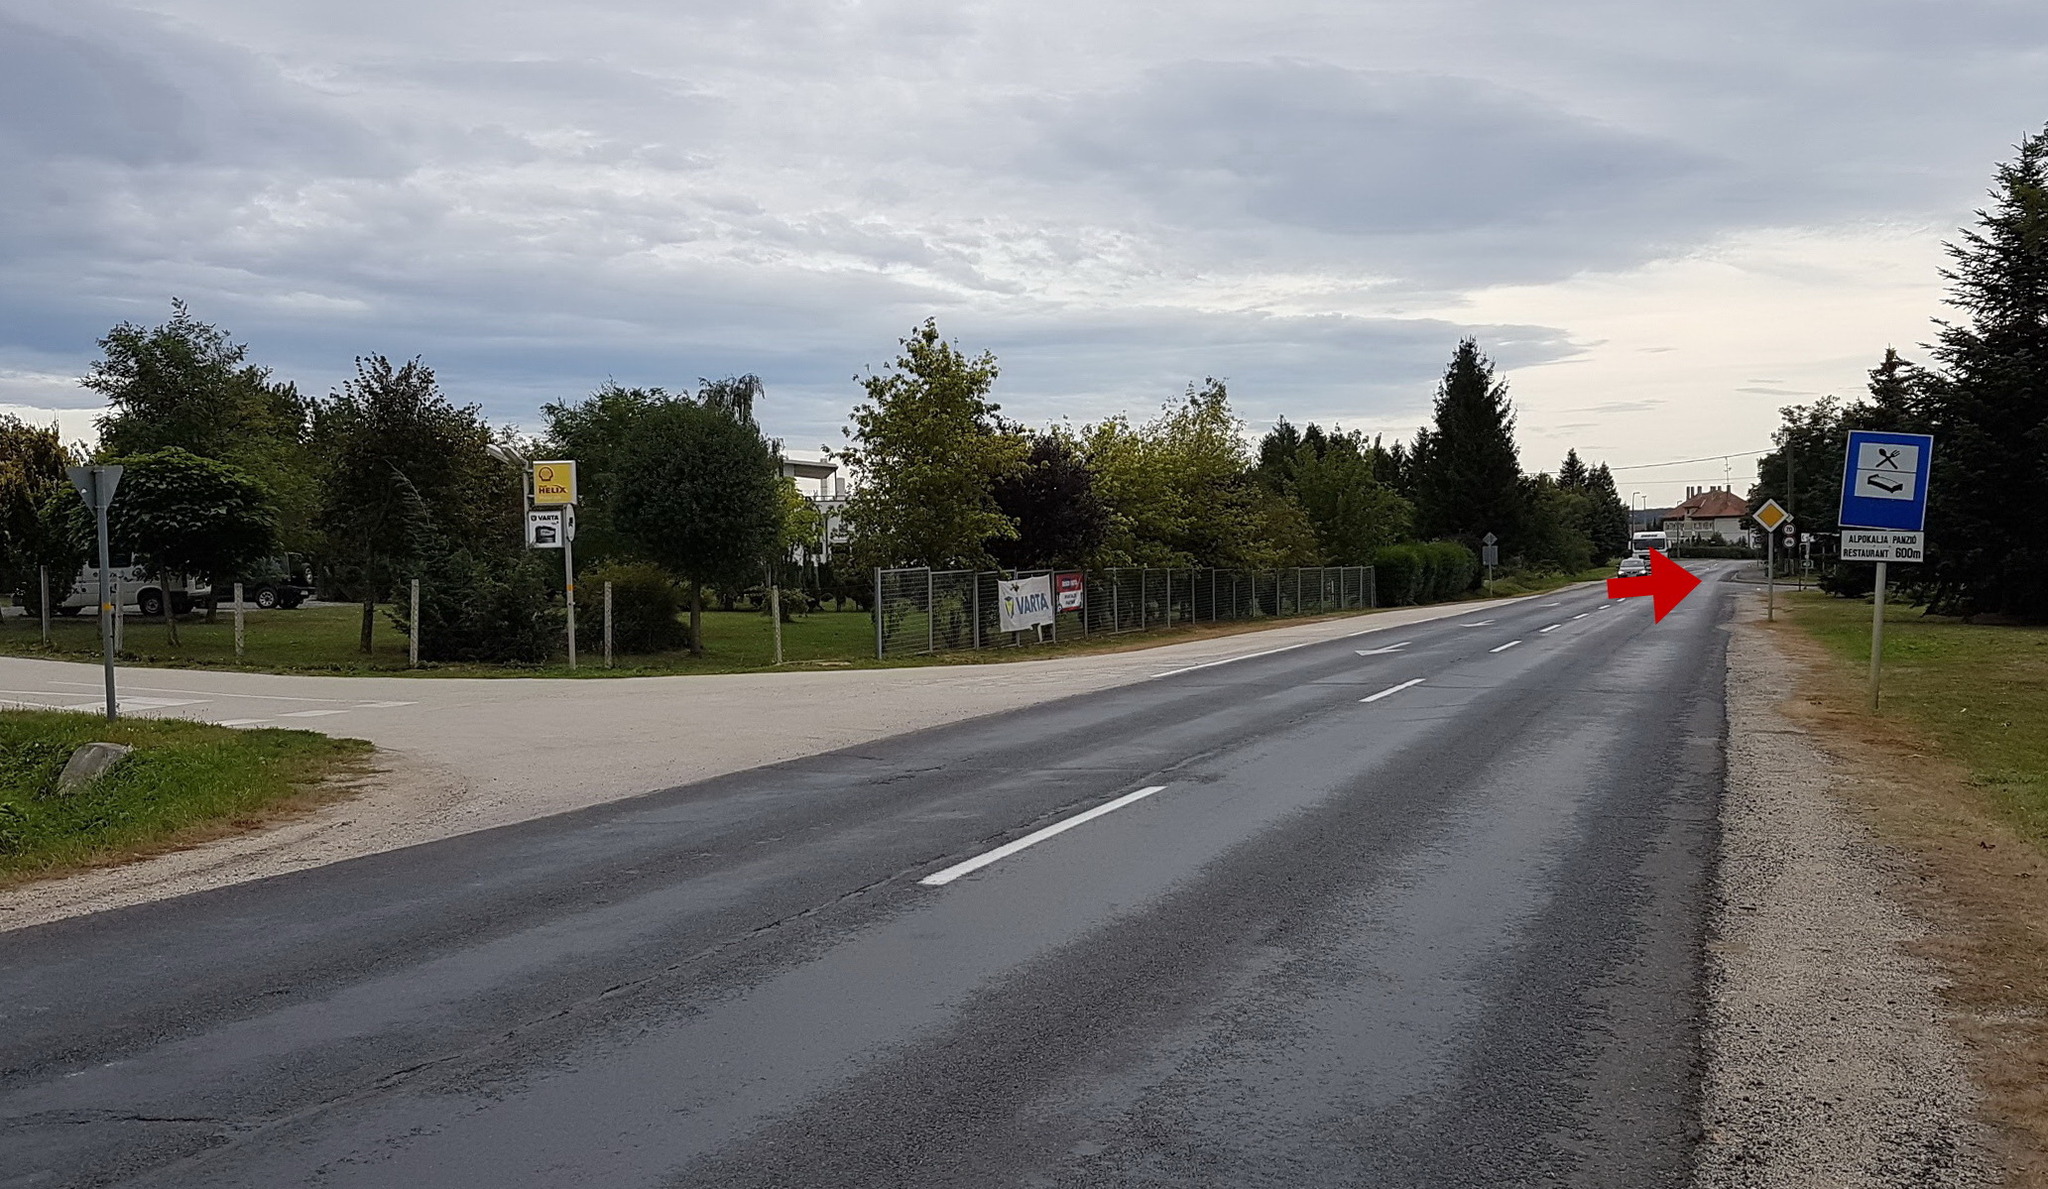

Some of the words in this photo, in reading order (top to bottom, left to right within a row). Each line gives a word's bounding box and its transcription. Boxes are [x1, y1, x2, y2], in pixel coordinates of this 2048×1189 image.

[538, 486, 567, 494] HELIX
[1848, 535, 1888, 544] ALPOKALJA
[1892, 535, 1917, 544] PANZIÓ
[1843, 548, 1889, 558] RESTAURANT
[1895, 547, 1921, 559] 600m
[1015, 593, 1049, 614] VARTA
